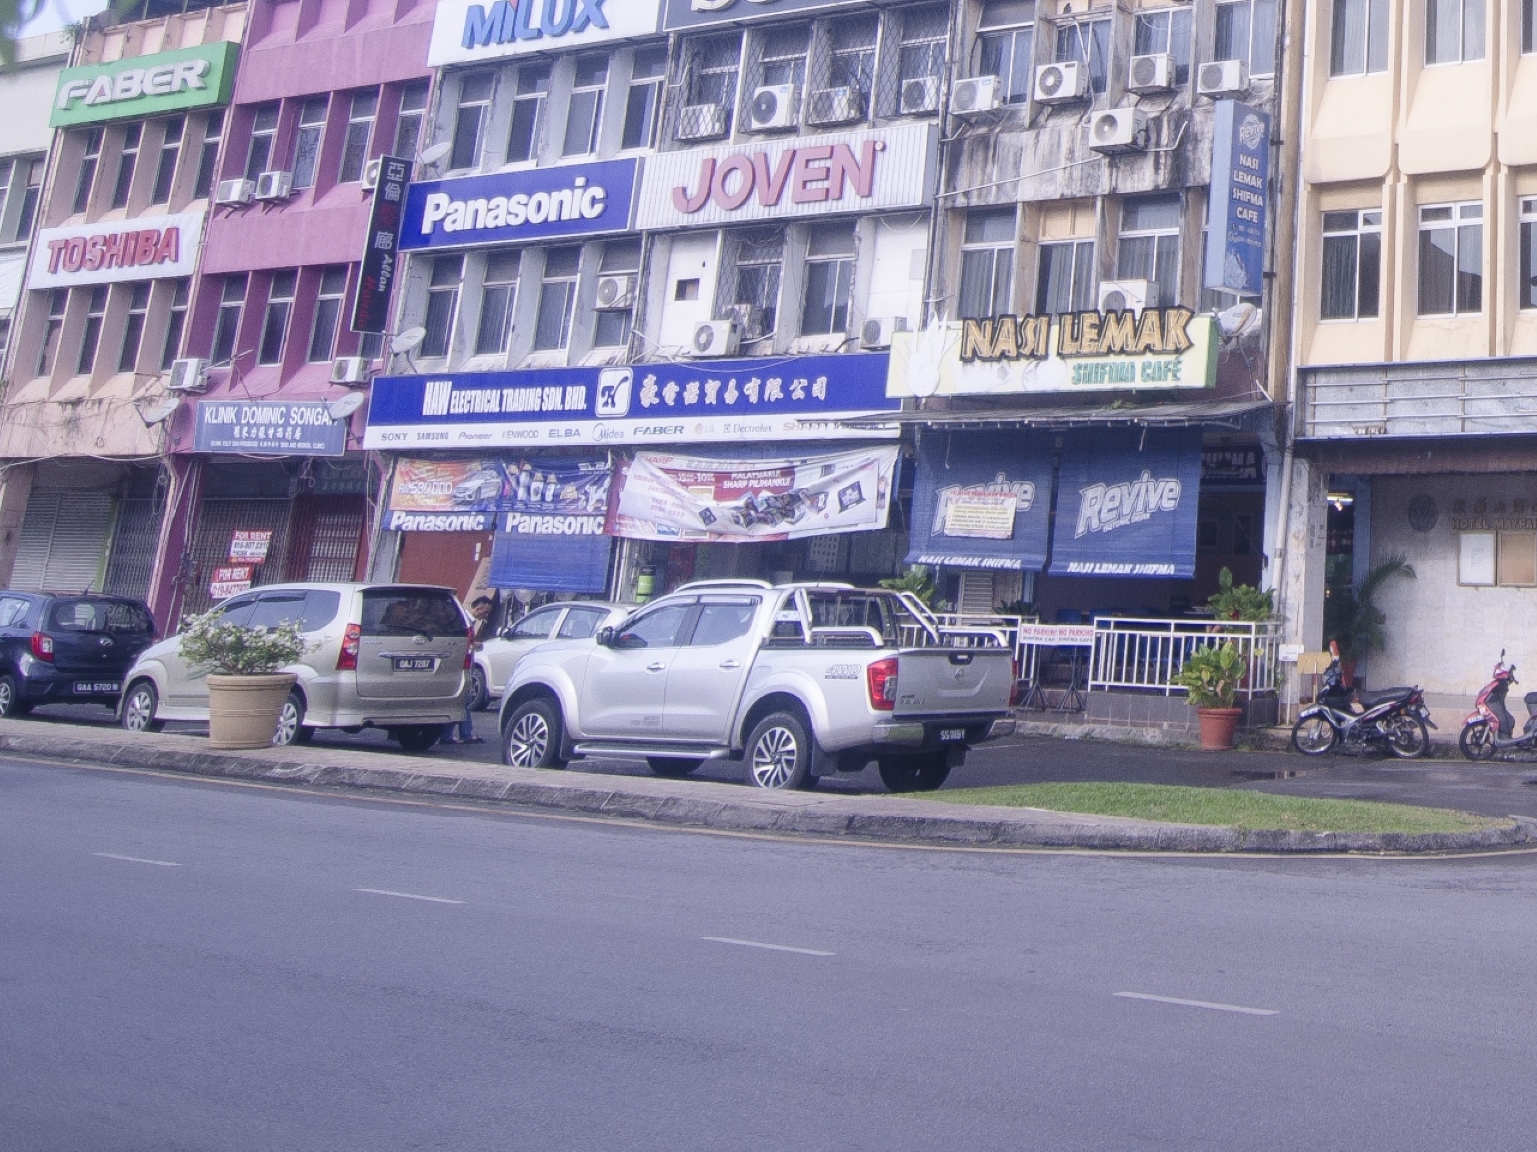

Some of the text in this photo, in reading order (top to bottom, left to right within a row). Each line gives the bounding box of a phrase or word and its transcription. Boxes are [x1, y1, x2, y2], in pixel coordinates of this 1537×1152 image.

[57, 59, 211, 110] FABER
[1239, 153, 1259, 171] NASI
[672, 140, 876, 214] JOVEN
[1233, 170, 1263, 189] LEMAK
[422, 177, 606, 235] Panasonic
[1232, 188, 1264, 207] SHIFMA
[1236, 209, 1259, 224] CAFE
[47, 227, 179, 275] TOSHIBA
[378, 253, 394, 292] Allan
[960, 304, 1196, 362] NASI LEMAK
[1072, 360, 1136, 385] SHIFMA
[422, 381, 587, 416] HAW ELECTRICAL TRADING SDN. BHD.
[204, 406, 338, 426] KLINIK DOMINIC SONGA
[381, 432, 409, 441] SONY
[416, 431, 449, 440] SAMSUNG
[458, 431, 494, 441] Pioneer
[502, 430, 539, 440] KENWOOD
[549, 428, 581, 438] ELBA
[594, 425, 624, 440] Midea
[633, 425, 685, 436] FABER
[732, 423, 773, 434] Electrolux
[723, 480, 748, 489] SHARP
[1075, 470, 1181, 539] Revive
[390, 510, 485, 531] Panasonic
[505, 512, 605, 535] Panasonic
[1453, 517, 1489, 530] HOTEL
[235, 530, 273, 540] FOR RENT
[918, 555, 944, 564] NASI
[943, 555, 982, 567] LEMAK
[1067, 562, 1093, 574] NASI
[1093, 563, 1132, 574] LEMAK
[218, 566, 250, 580] FOR RENT
[1033, 628, 1057, 637] PARKIN
[1068, 629, 1093, 637] PARKING
[824, 664, 862, 675] 4WD
